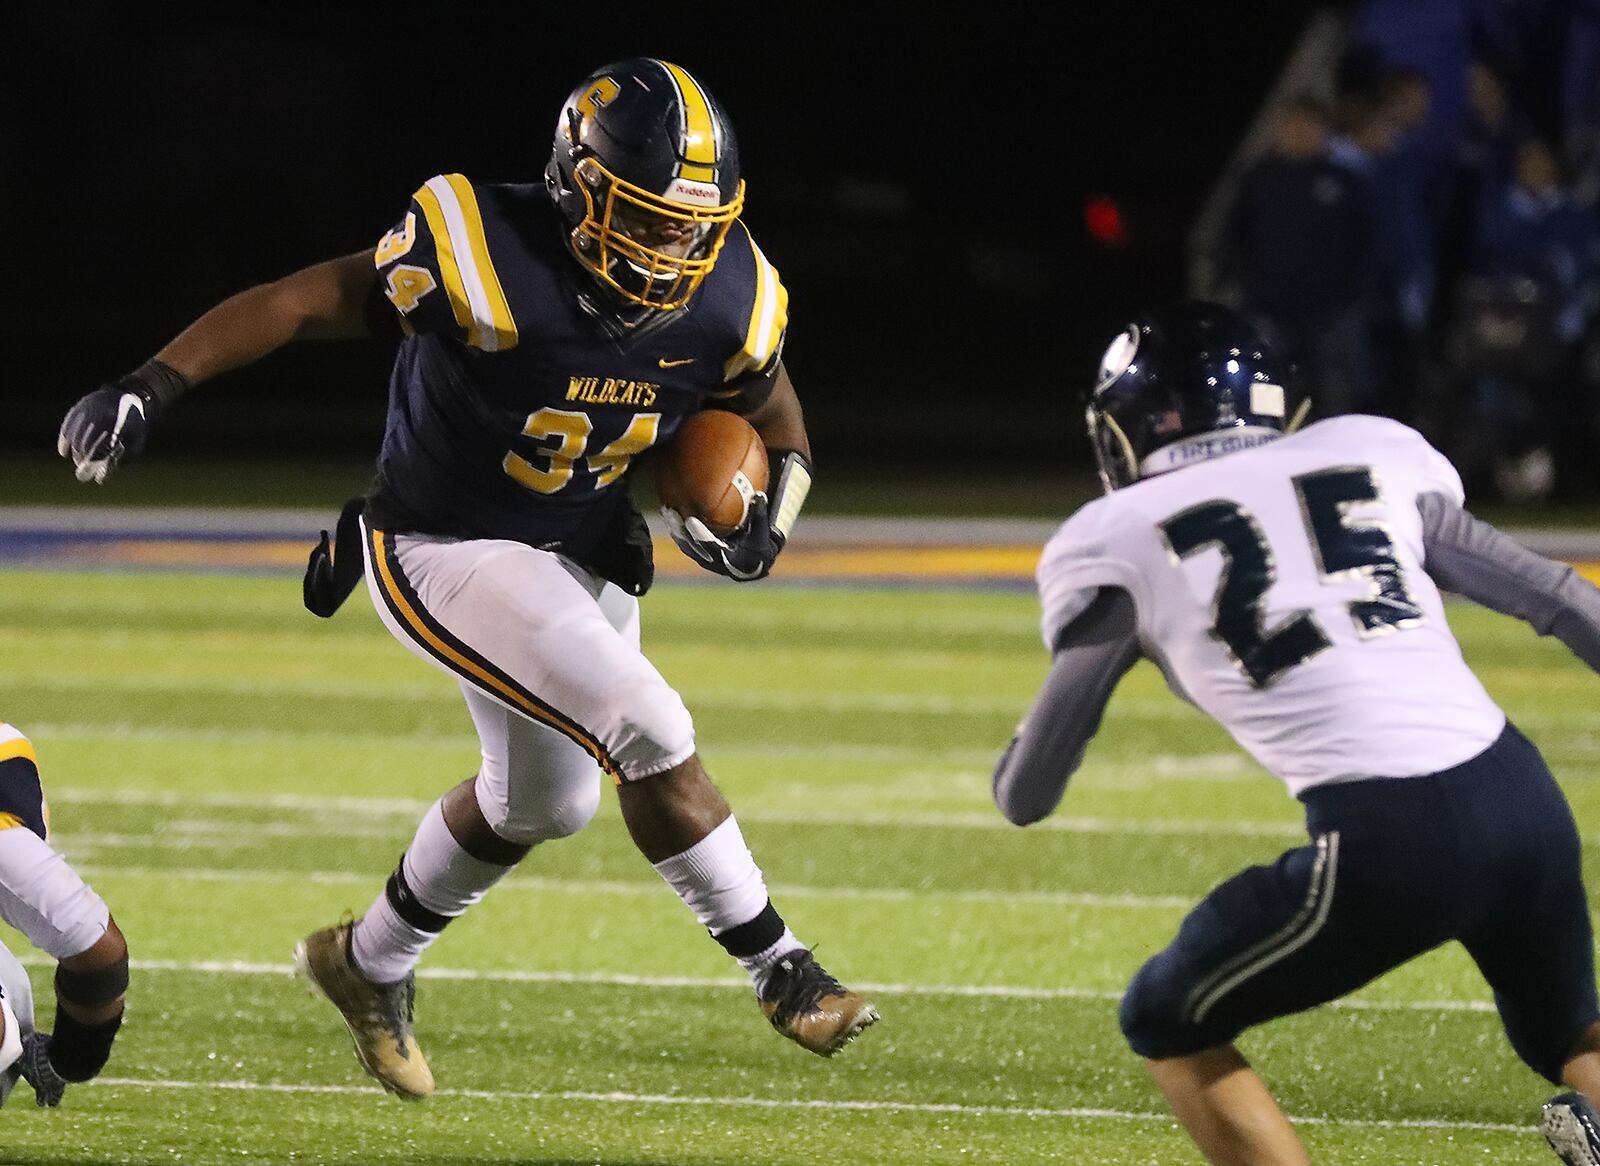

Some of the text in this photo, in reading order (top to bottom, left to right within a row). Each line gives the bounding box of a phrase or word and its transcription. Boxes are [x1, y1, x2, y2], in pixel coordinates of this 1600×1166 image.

[565, 376, 660, 406] WILDCATS
[502, 406, 662, 494] 34
[1154, 464, 1428, 689] 25
